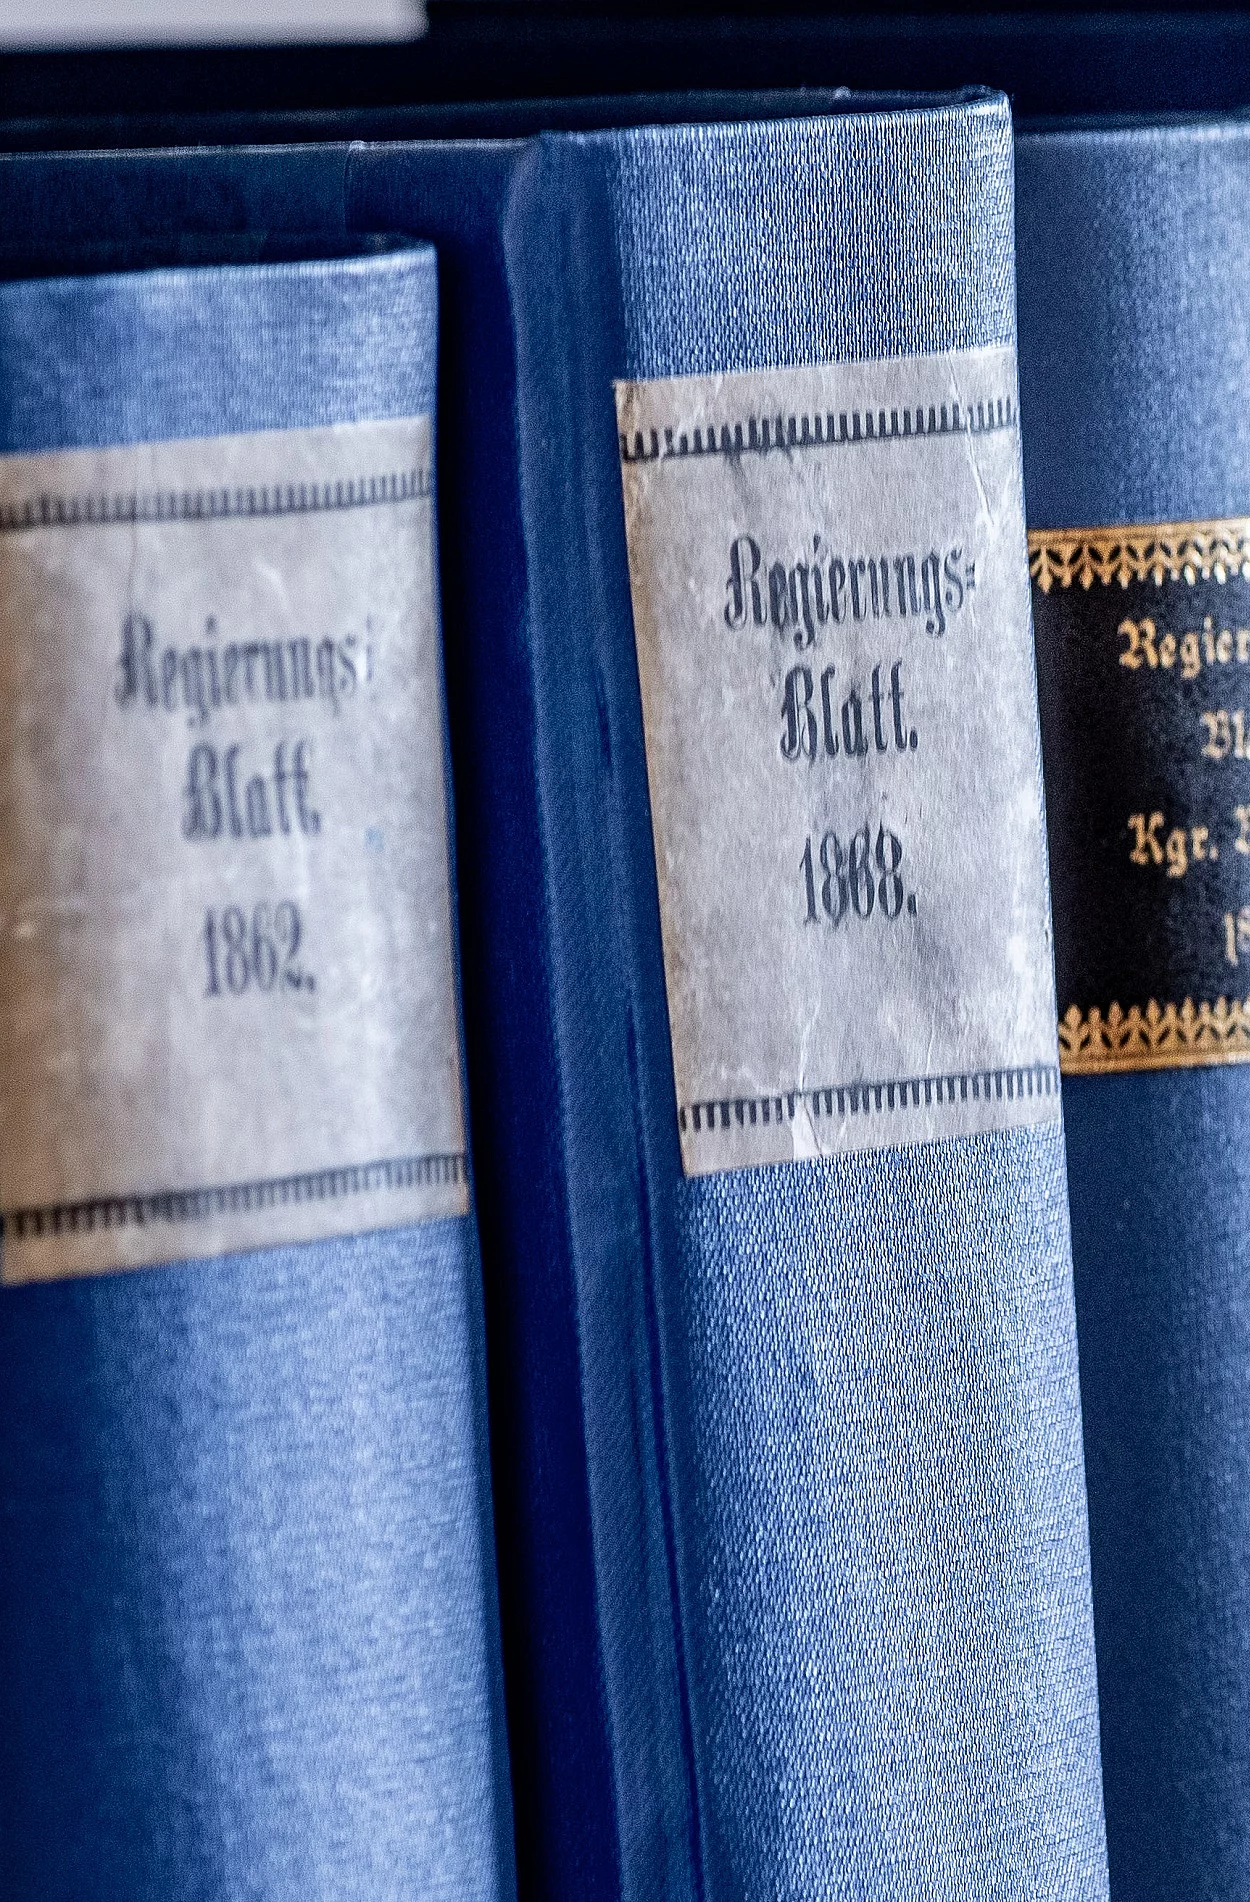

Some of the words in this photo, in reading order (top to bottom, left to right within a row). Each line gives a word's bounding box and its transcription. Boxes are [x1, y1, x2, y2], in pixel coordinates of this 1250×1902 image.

[779, 661, 919, 766] Blatt.
[182, 738, 322, 842] Blatt.
[799, 822, 919, 926] 1868.
[1127, 810, 1219, 878] Kgr.
[203, 898, 318, 998] 1862.
